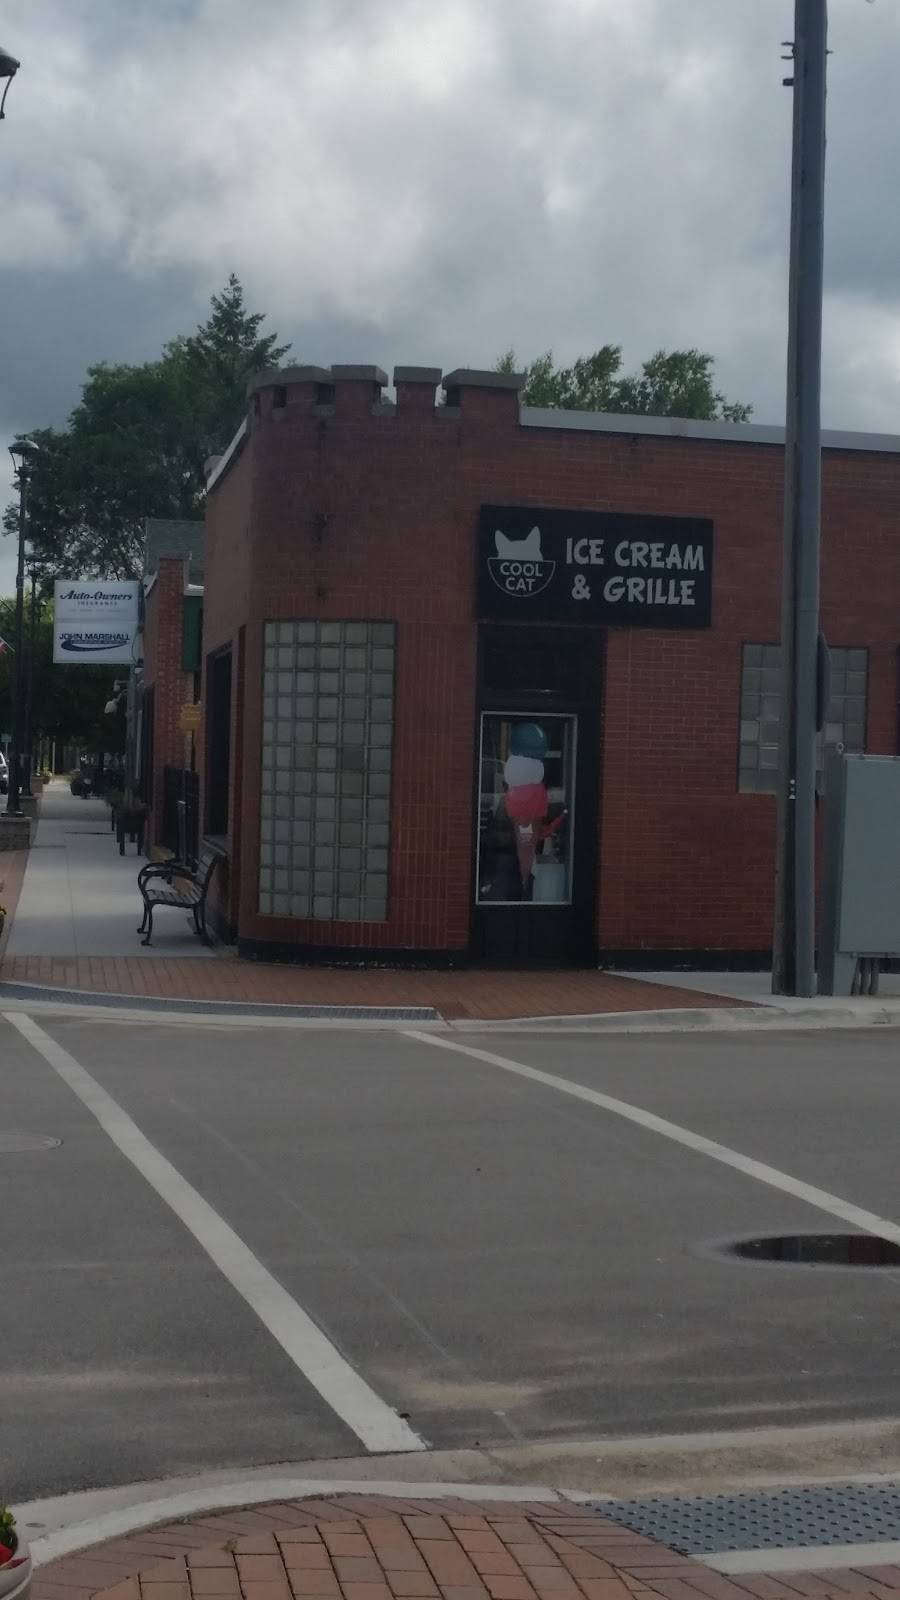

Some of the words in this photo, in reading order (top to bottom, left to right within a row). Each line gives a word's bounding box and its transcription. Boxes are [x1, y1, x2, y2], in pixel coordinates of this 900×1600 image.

[566, 538, 604, 565] ICE
[614, 541, 704, 571] CREAM
[500, 562, 543, 577] COOL
[505, 577, 536, 591] CAT
[571, 574, 591, 601] &
[603, 576, 696, 605] GRILLE
[60, 590, 133, 601] Auto-Owners
[59, 633, 83, 641] JOHN
[85, 633, 130, 641] MARSHALL
